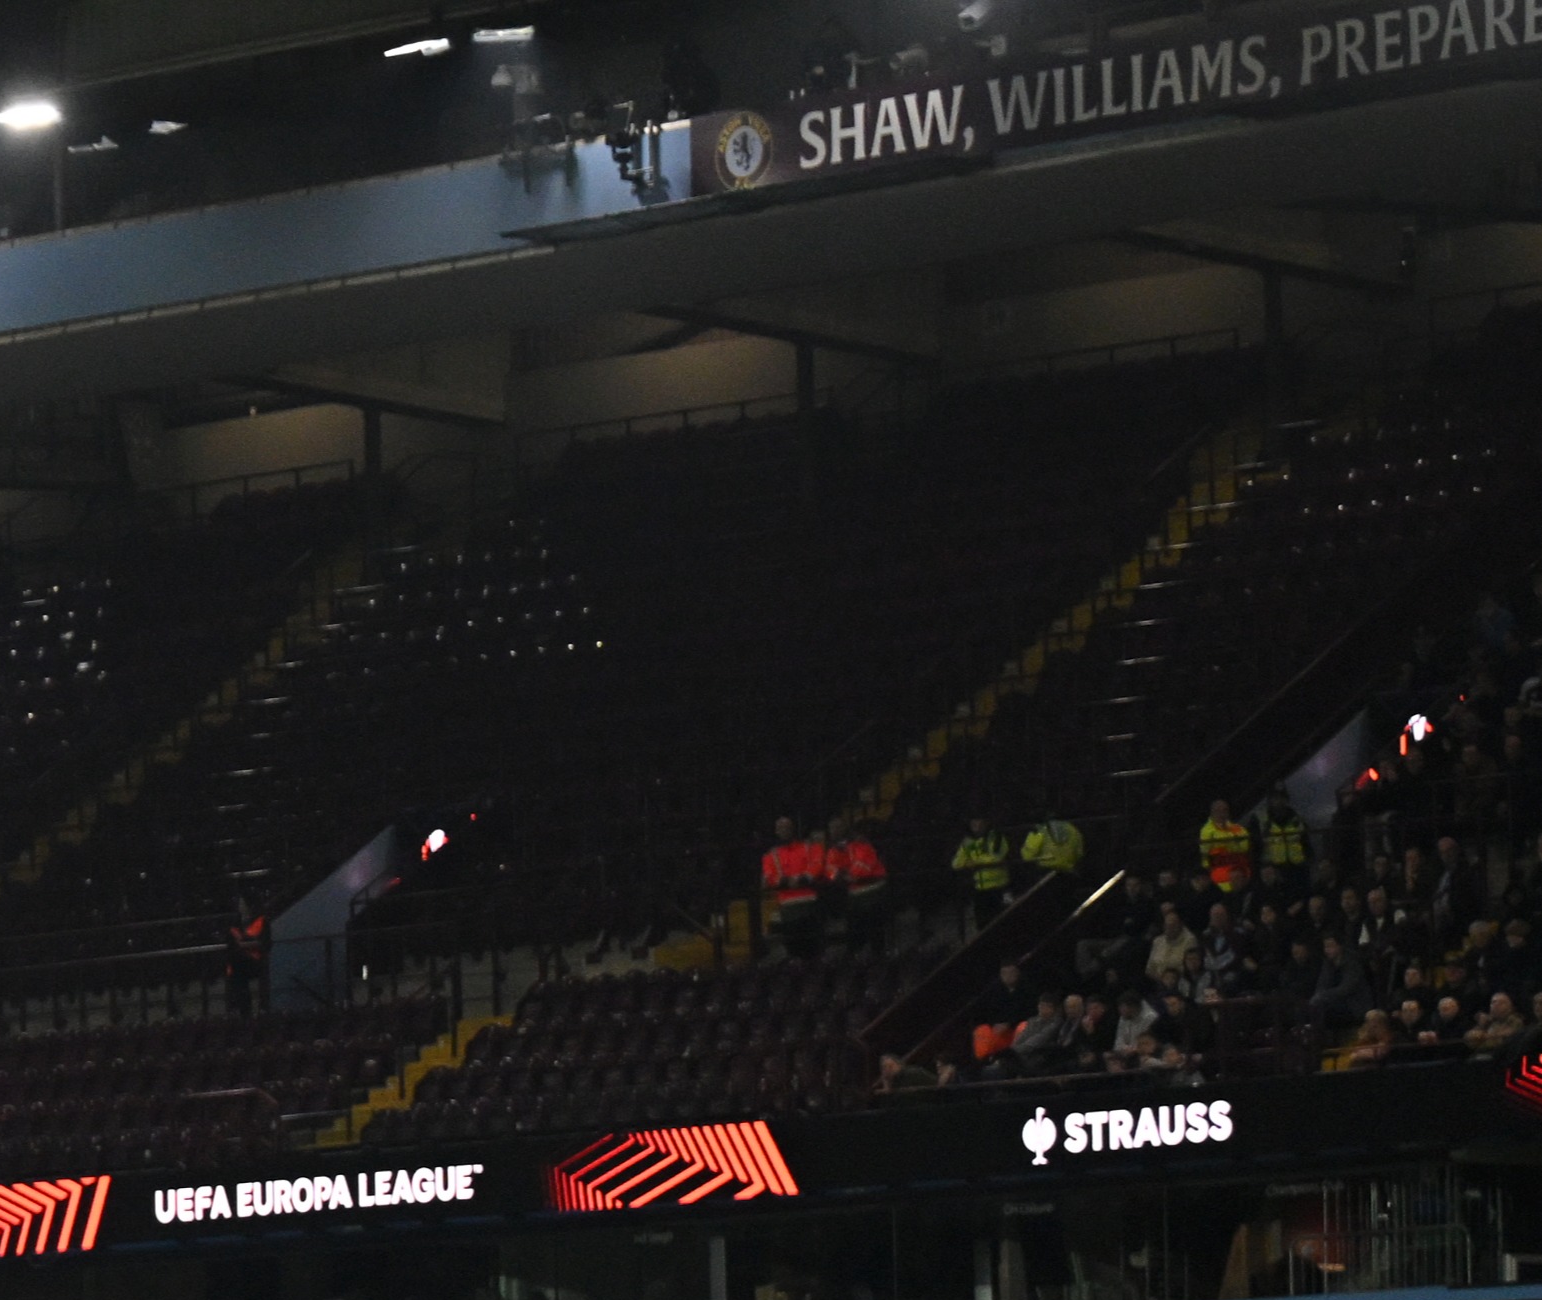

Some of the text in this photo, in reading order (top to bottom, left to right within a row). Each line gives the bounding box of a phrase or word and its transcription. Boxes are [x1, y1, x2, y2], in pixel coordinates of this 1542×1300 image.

[798, 84, 975, 171] SHAW,
[987, 35, 1282, 136] WILLIAMS,
[1064, 1100, 1233, 1154] STRAUSS
[154, 1184, 232, 1224] UEFA
[236, 1174, 353, 1218] EUROPA
